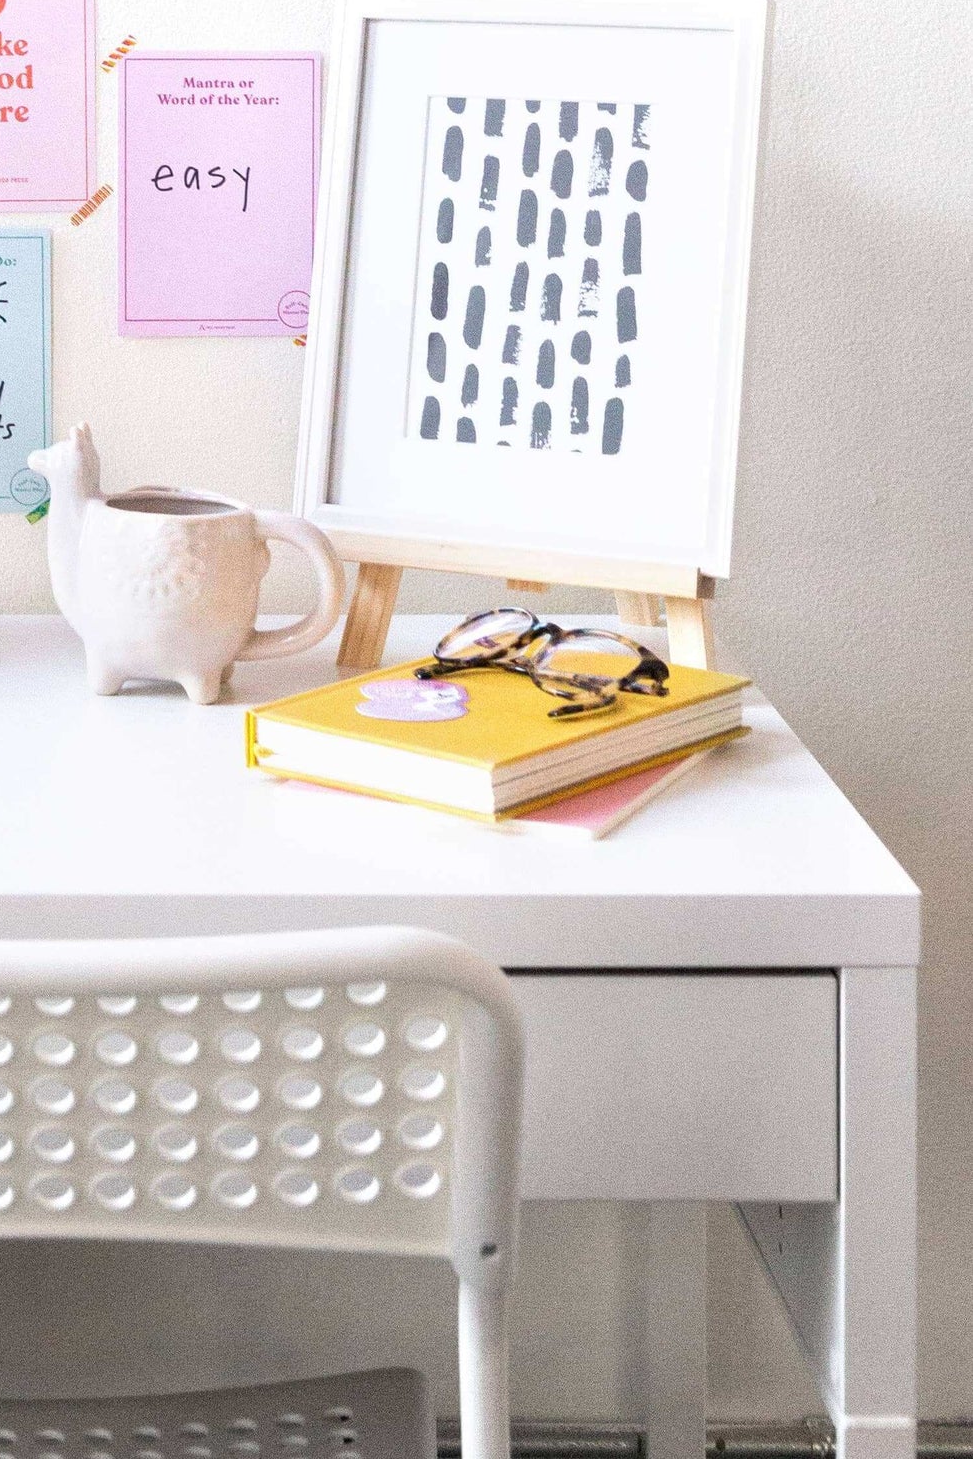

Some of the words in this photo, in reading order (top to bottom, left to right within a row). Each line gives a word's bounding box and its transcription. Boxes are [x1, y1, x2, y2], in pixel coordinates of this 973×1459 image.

[183, 77, 236, 89] Mantra
[239, 78, 255, 89] or
[157, 94, 196, 106] Word
[200, 94, 215, 106] of
[218, 94, 240, 106] the
[244, 94, 280, 106] Year:
[151, 165, 250, 212] easy
